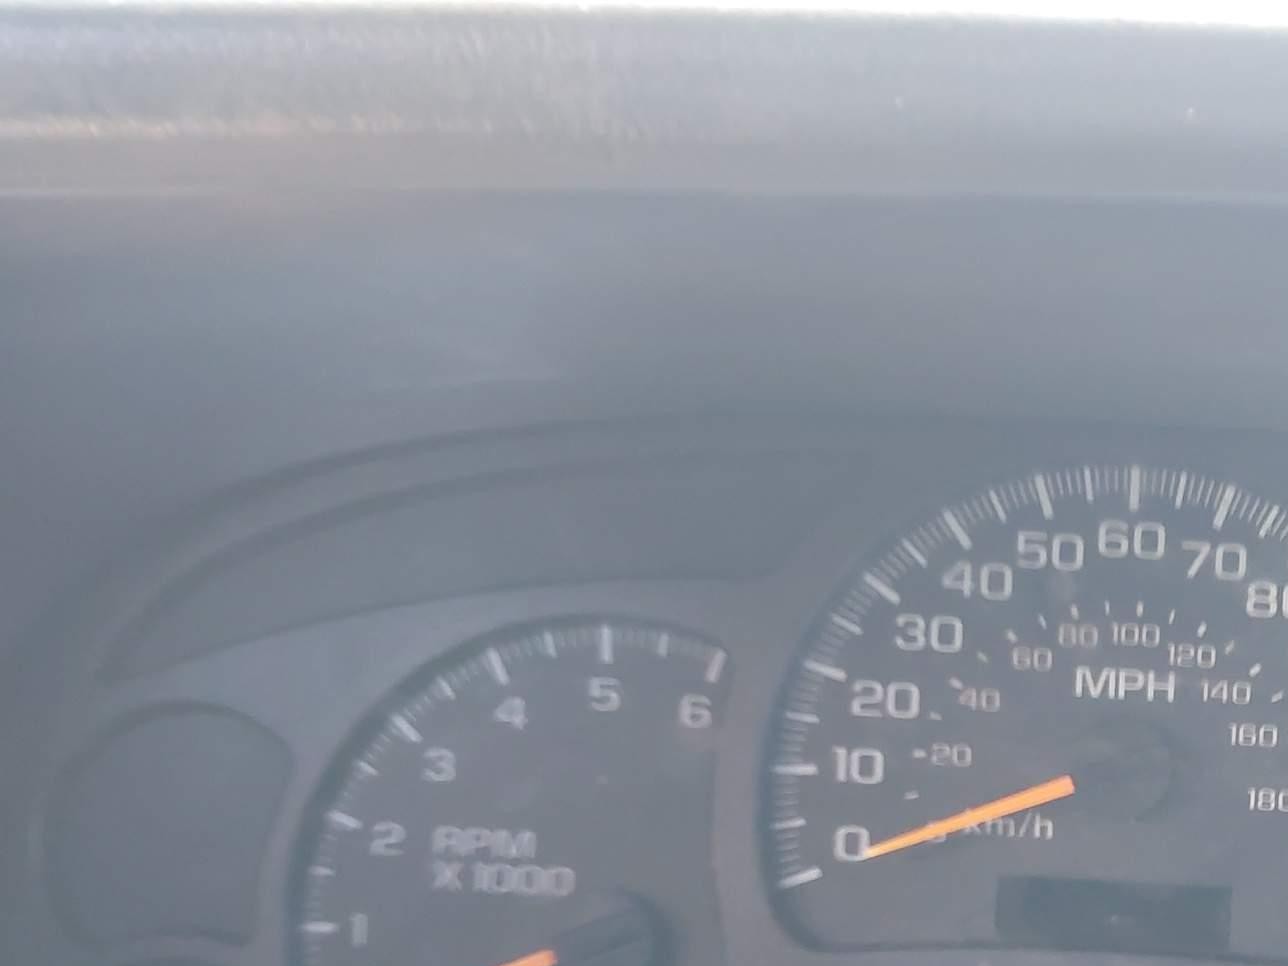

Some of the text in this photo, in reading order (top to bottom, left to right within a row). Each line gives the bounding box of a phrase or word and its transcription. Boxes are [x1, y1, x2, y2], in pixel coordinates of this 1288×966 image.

[1016, 530, 1084, 571] 50
[1098, 520, 1166, 560] 60
[1182, 540, 1247, 581] 70
[941, 560, 1013, 601] 40
[895, 613, 964, 653] 30
[1059, 624, 1098, 648] 80
[1111, 623, 1160, 648] 100
[1012, 645, 1052, 671] 60
[1167, 643, 1216, 669] 120
[588, 676, 622, 712] 5
[850, 680, 920, 720] 20
[958, 688, 1000, 712] 40
[1074, 665, 1176, 702] MPH
[1201, 679, 1252, 705] 140
[493, 696, 528, 730] 4
[678, 693, 712, 730] 6
[1229, 722, 1278, 748] 160
[421, 747, 457, 783] 3
[832, 746, 884, 784] 10
[930, 743, 972, 767] 20
[369, 821, 406, 857] 2
[431, 825, 537, 859] RPM
[833, 824, 870, 862] 0
[349, 912, 368, 947] 1
